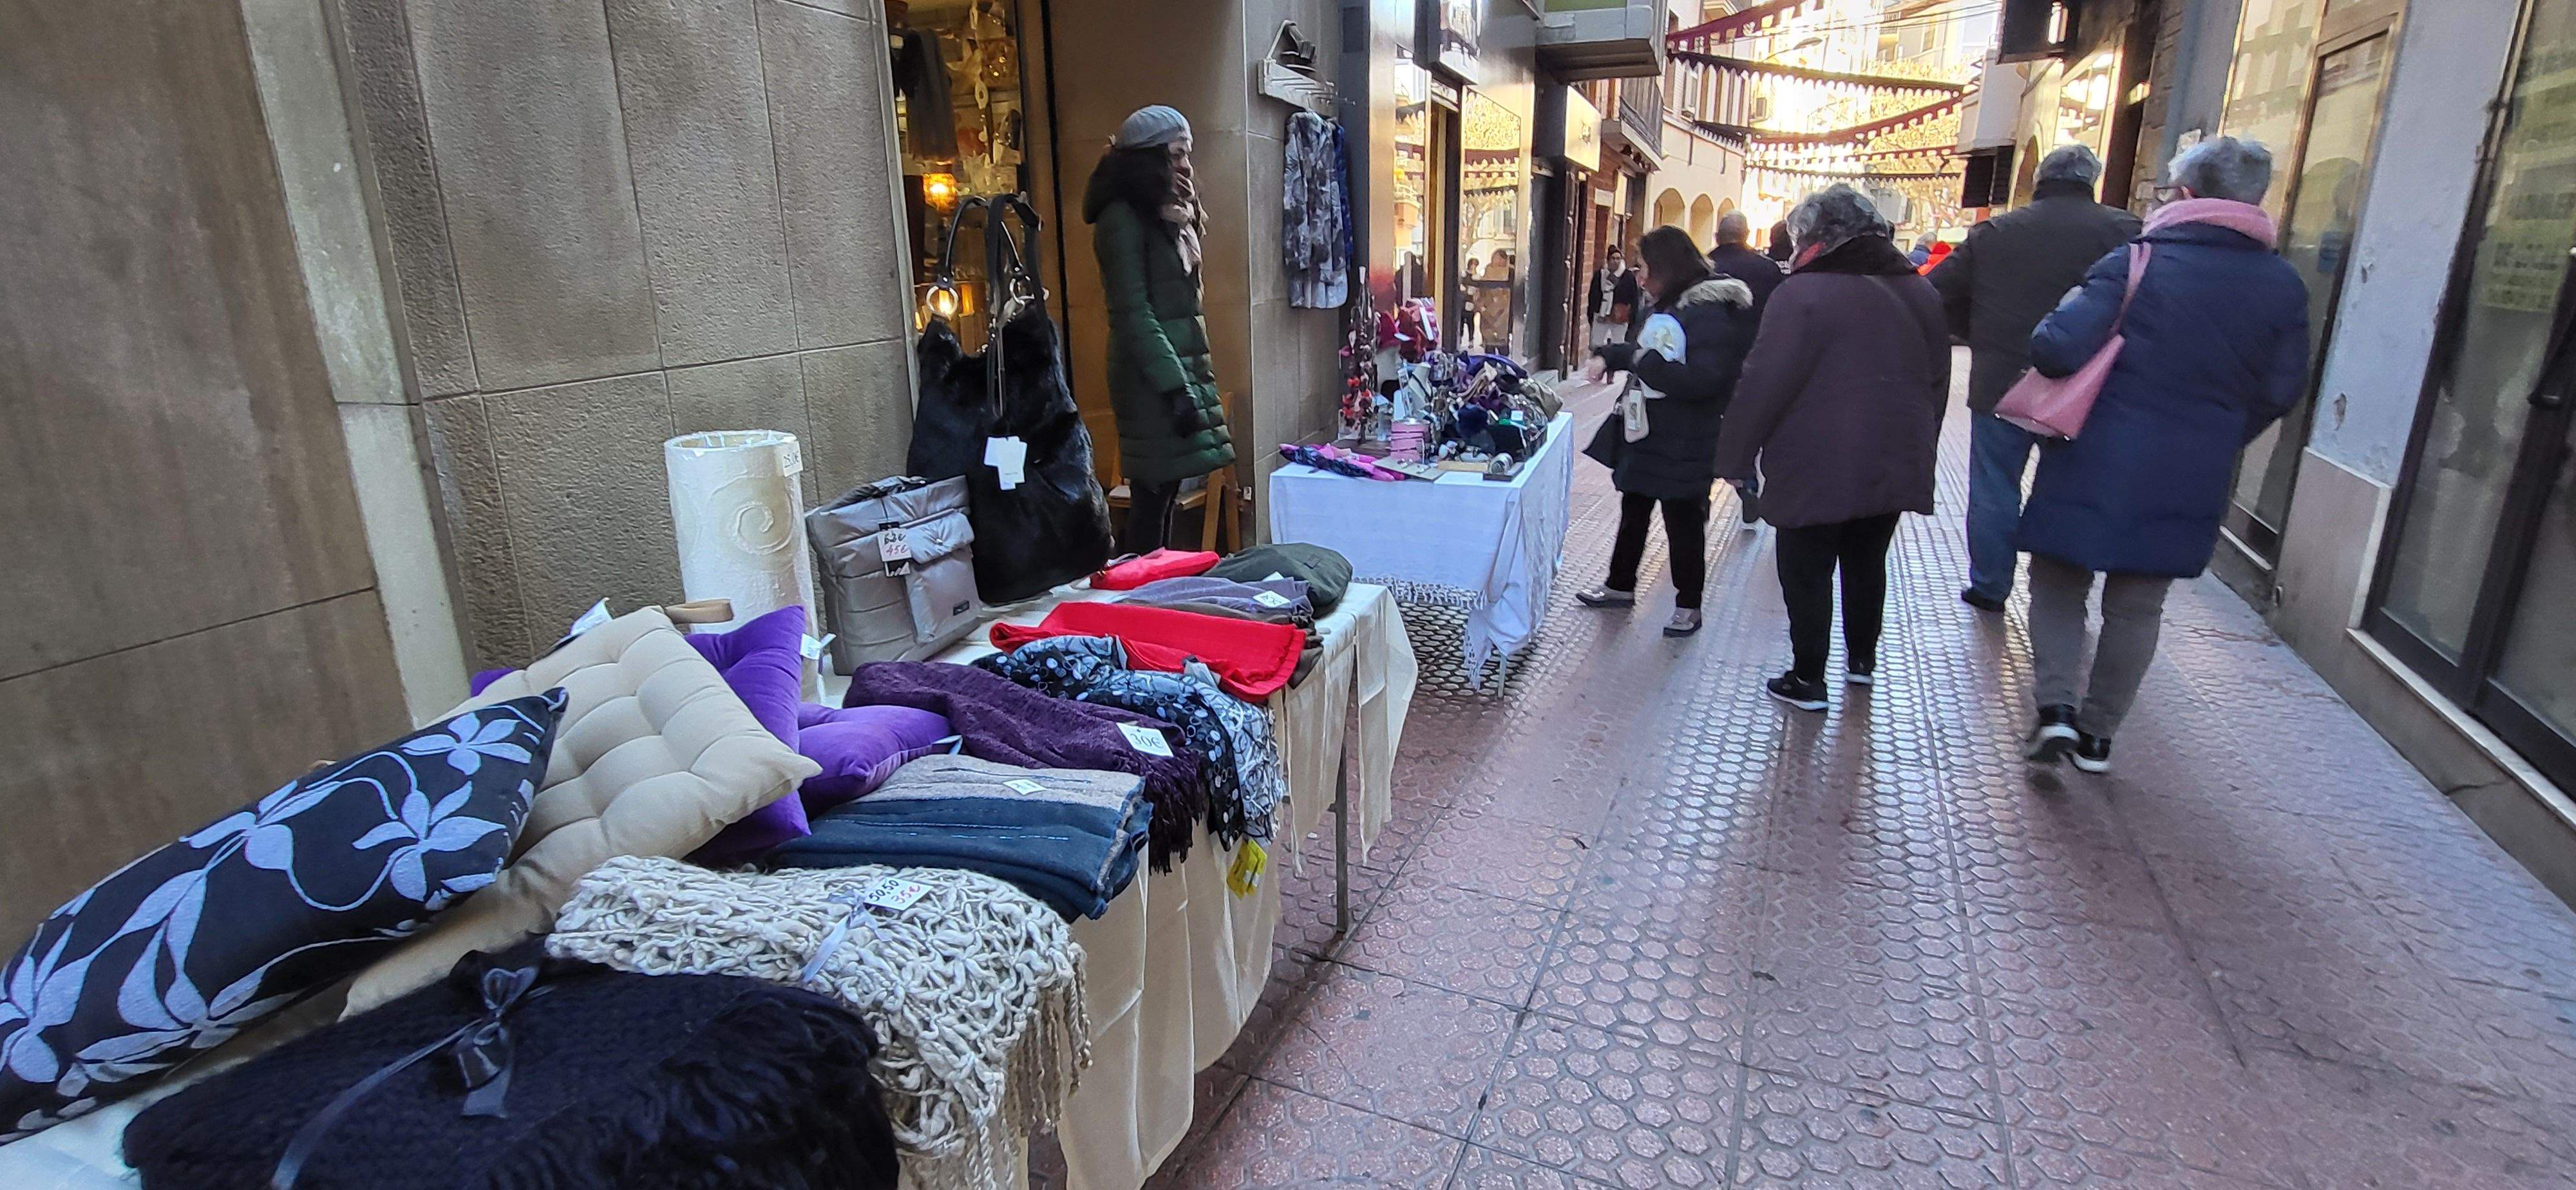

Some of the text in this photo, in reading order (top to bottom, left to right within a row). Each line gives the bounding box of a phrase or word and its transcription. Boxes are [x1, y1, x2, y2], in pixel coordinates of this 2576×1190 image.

[886, 544, 908, 556] 45€
[1130, 733, 1164, 748] 30€
[869, 880, 899, 902] 50,50
[891, 885, 921, 903] 35€
